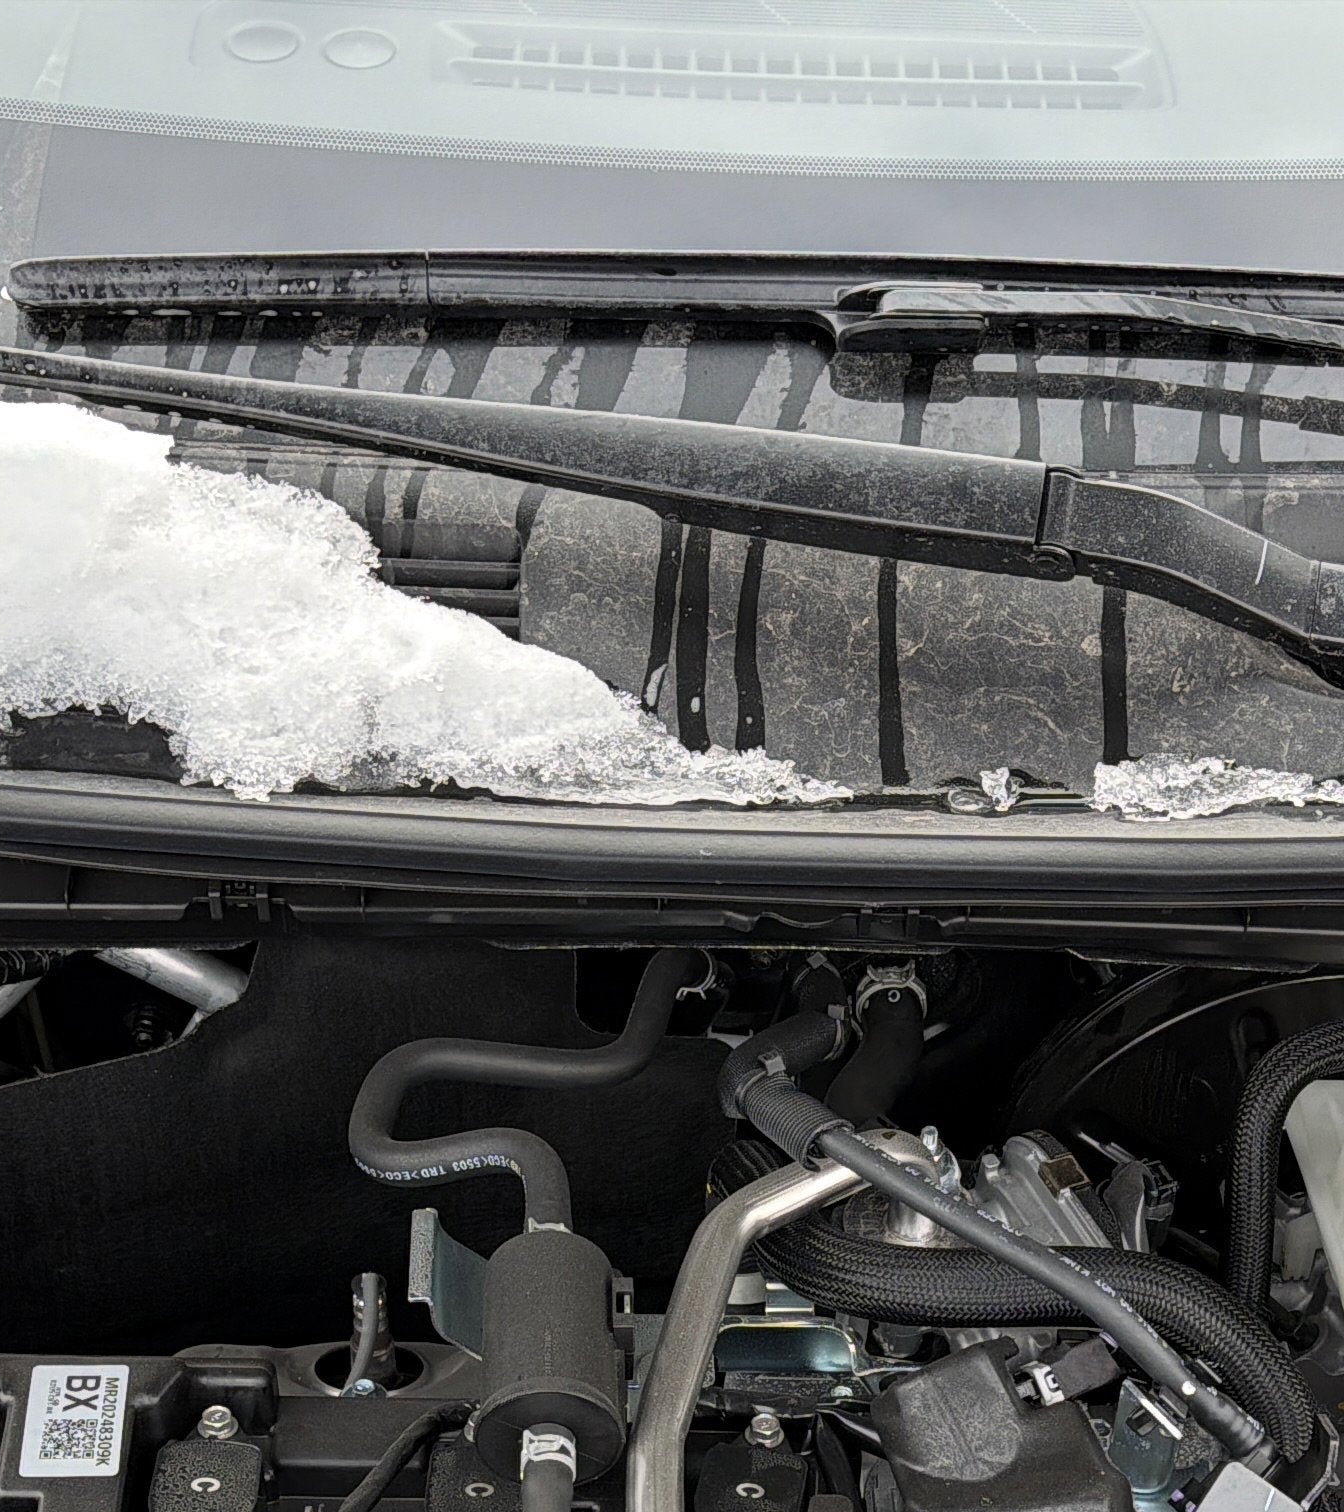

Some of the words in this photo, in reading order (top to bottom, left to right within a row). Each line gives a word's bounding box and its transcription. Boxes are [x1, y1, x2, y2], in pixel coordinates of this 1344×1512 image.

[62, 1374, 101, 1412] BX
[96, 1377, 119, 1466] MR20248309K
[191, 1477, 221, 1492] C
[465, 1482, 494, 1498] C
[735, 1482, 766, 1499] C
